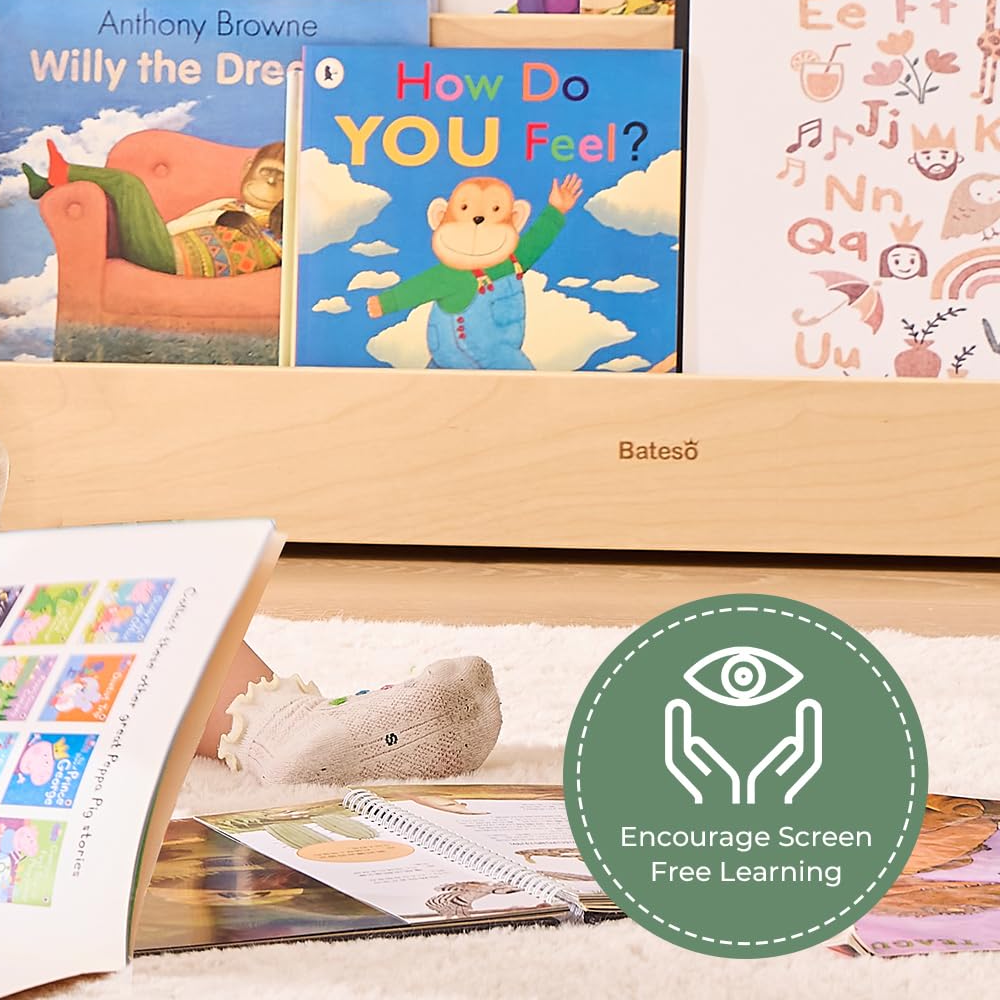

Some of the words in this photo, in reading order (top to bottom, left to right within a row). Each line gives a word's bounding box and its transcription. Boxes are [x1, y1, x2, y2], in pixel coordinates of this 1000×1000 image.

[98, 10, 207, 43] Anthony
[217, 10, 319, 38] Browne
[30, 48, 127, 92] Willy
[137, 50, 201, 85] the
[396, 61, 504, 101] How
[522, 62, 590, 102] Do
[334, 115, 500, 168] YOU
[525, 120, 649, 162] Feel?
[825, 174, 903, 212] Nn
[111, 714, 131, 749] great
[44, 758, 72, 806] George
[56, 768, 80, 806] Prince
[95, 754, 119, 791] Peppa
[82, 797, 104, 819] Pig
[72, 825, 93, 878] stories
